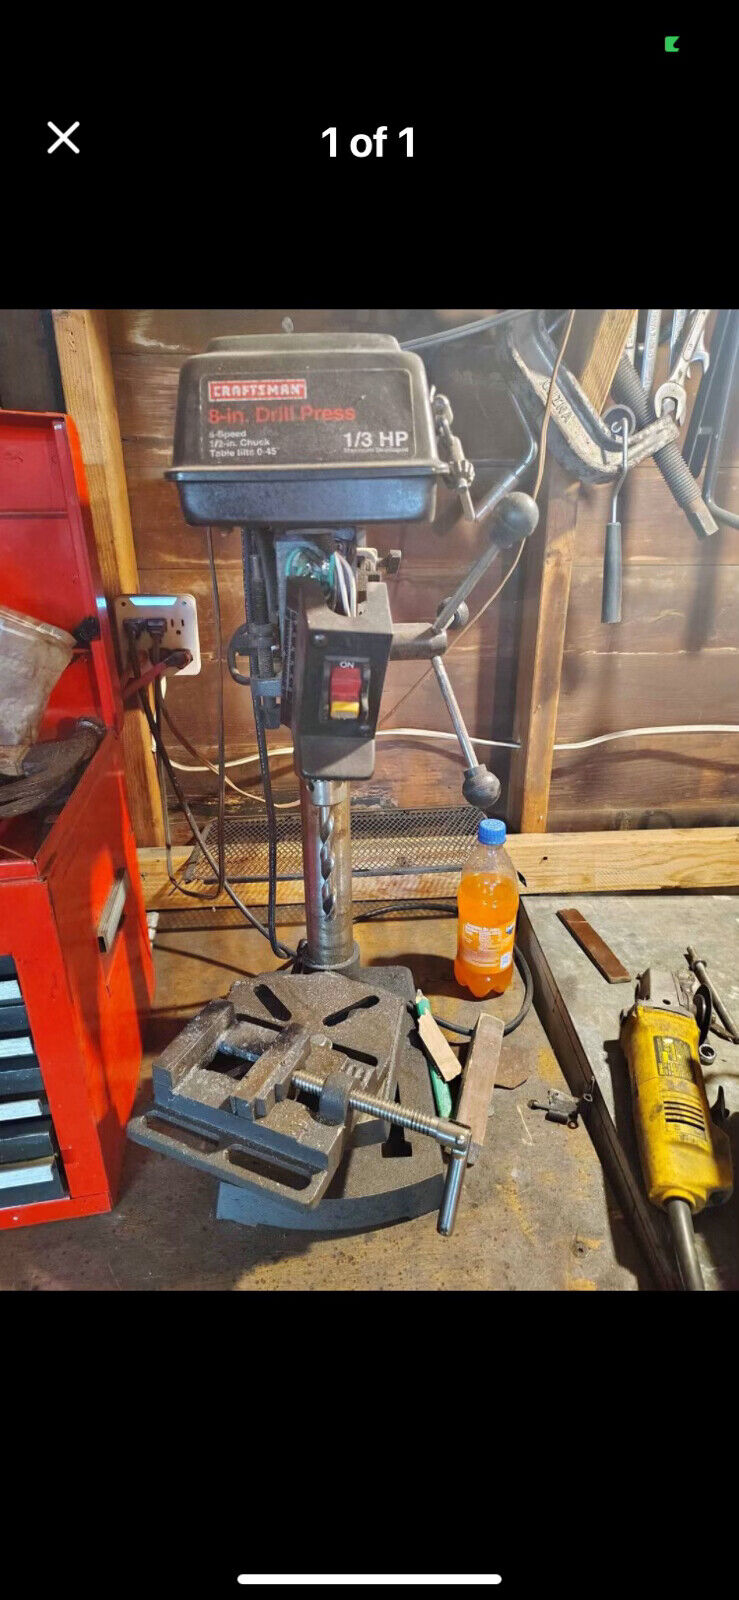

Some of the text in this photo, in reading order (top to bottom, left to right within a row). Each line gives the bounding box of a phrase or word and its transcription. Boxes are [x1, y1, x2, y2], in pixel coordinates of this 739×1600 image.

[212, 383, 302, 398] CRAFTSMAN
[208, 404, 356, 425] 8-in. Drill Press
[239, 438, 271, 447] Chuck
[343, 430, 409, 448] 1/3 HP
[209, 449, 236, 458] Table
[340, 660, 355, 669] ON
